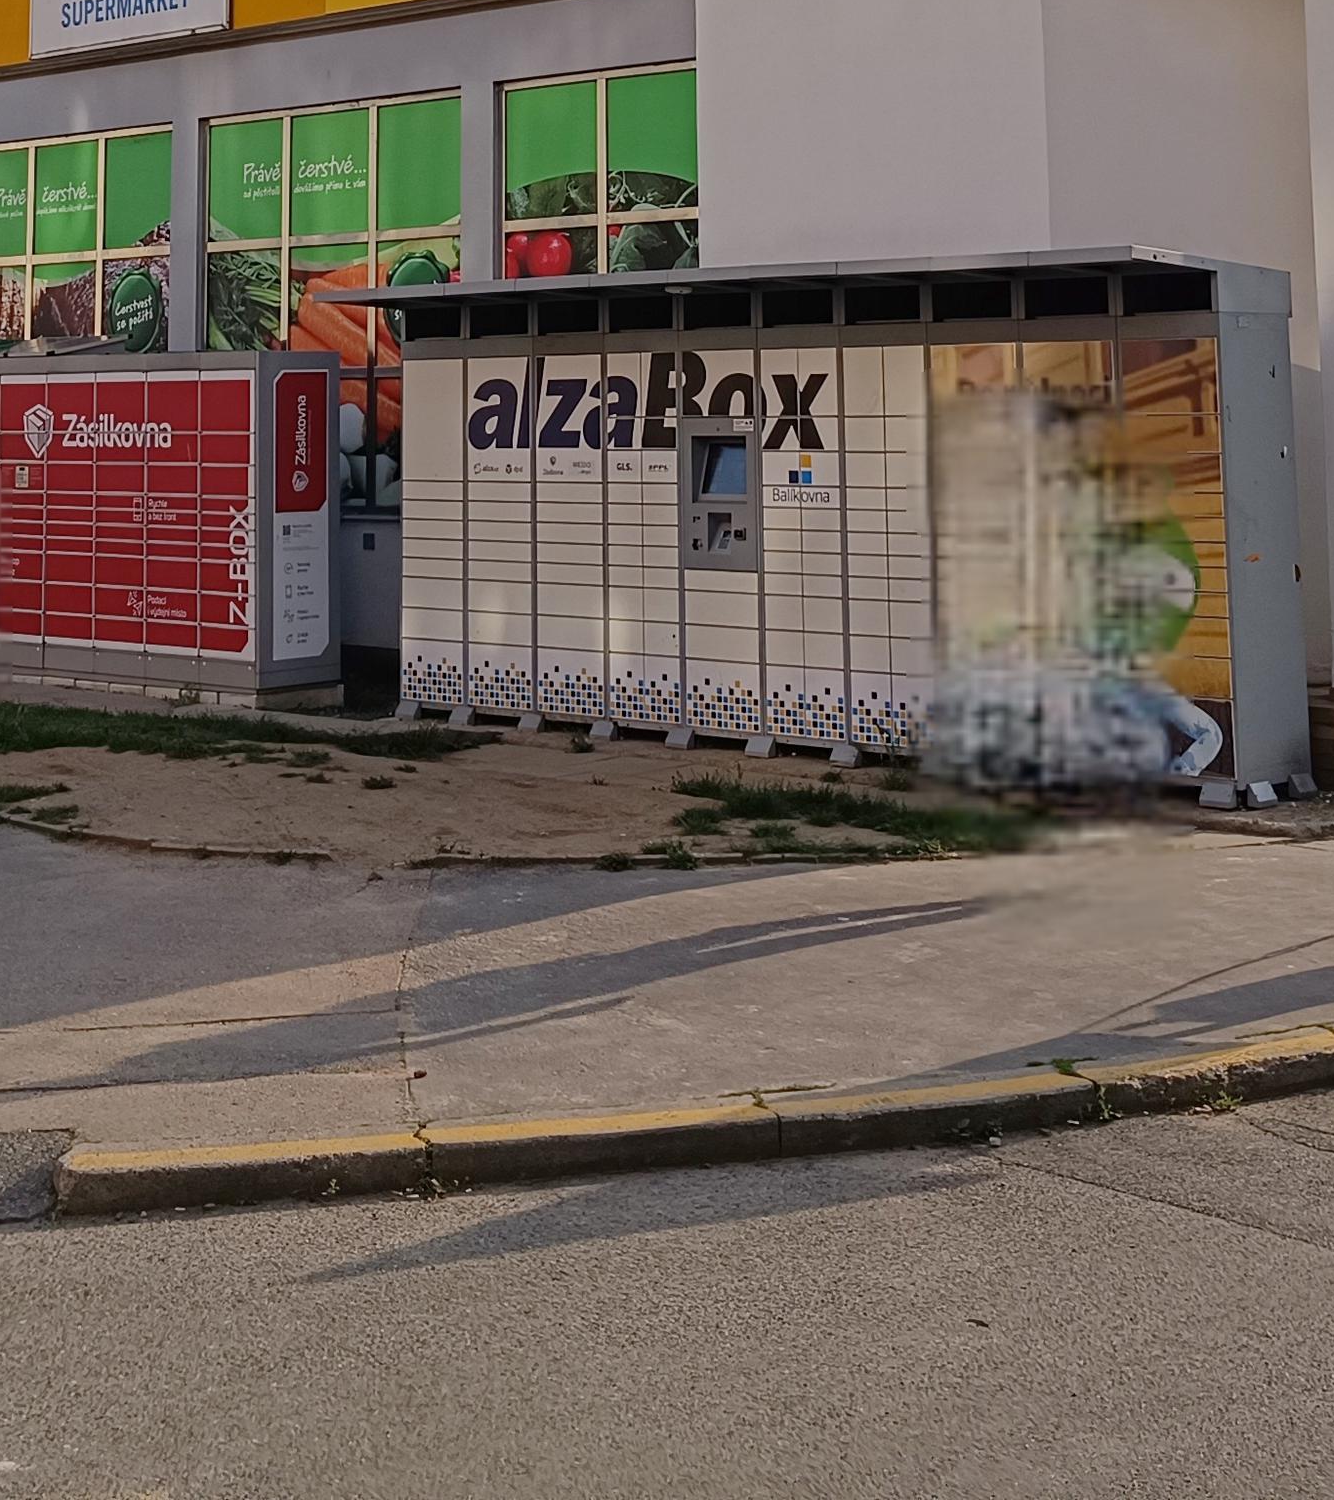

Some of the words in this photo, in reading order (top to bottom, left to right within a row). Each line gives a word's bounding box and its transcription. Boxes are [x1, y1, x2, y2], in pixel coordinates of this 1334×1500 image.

[244, 162, 281, 184] Právě
[62, 414, 172, 448] Zásilkovna
[295, 395, 306, 465] Zásilkovna
[772, 488, 830, 503] Balíkovna
[229, 505, 249, 625] Z-BOX
